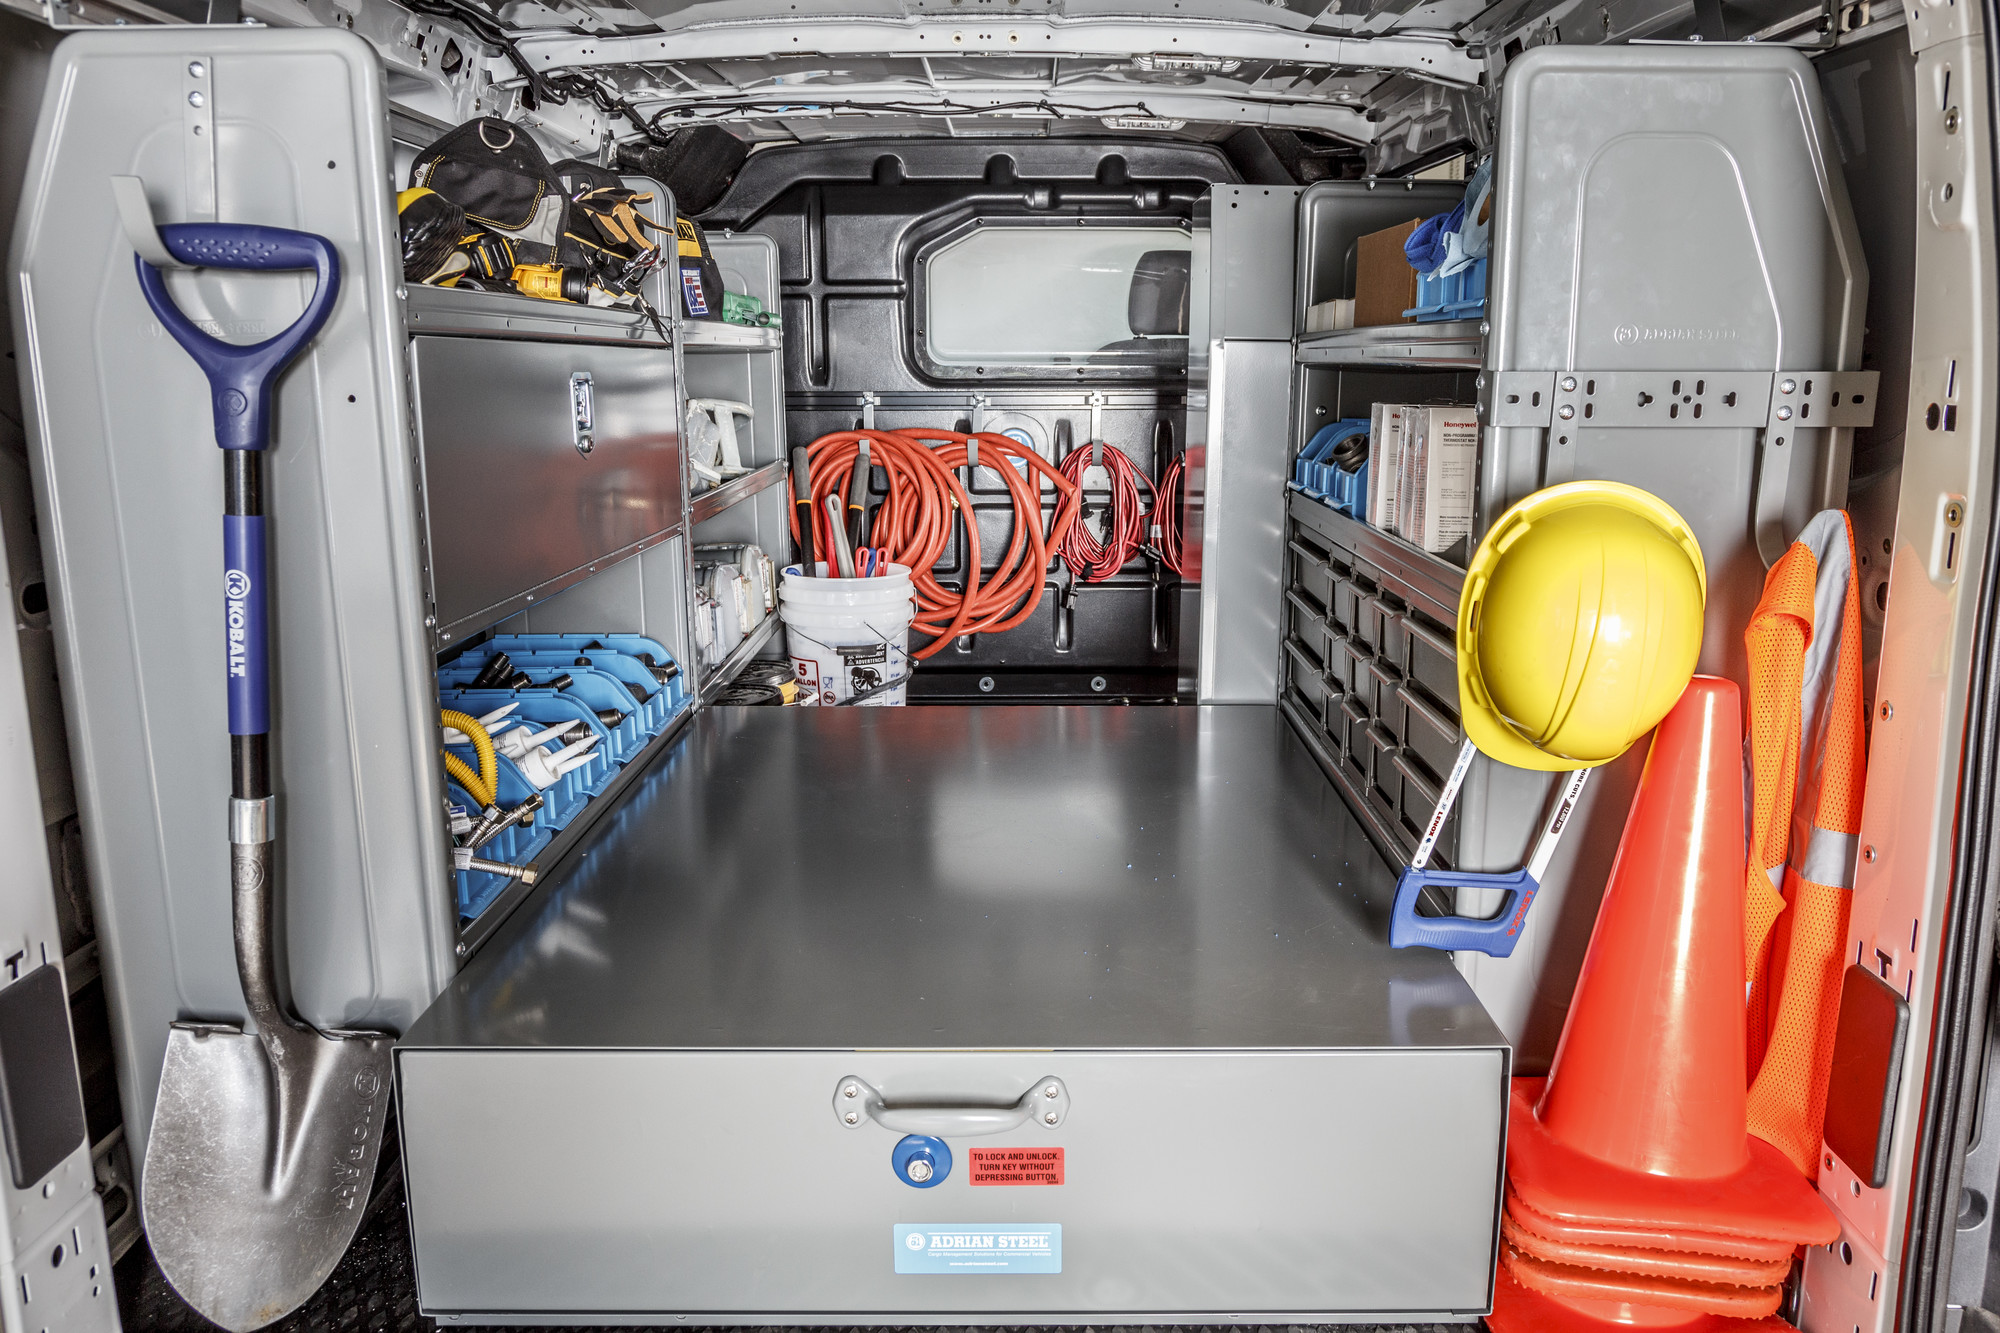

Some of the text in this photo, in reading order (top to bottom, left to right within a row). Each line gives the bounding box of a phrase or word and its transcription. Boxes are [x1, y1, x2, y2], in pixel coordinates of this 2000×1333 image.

[228, 600, 246, 677] KOBALT
[855, 657, 885, 665] ADVERTENCIA
[798, 663, 808, 676] 5
[1429, 811, 1443, 837] LENOX
[1512, 890, 1534, 930] LENOX
[973, 1153, 983, 1161] TO
[985, 1153, 1006, 1161] LOCK
[1007, 1152, 1024, 1160] AND
[979, 1163, 1055, 1171] TURN KEY WITHOUT
[975, 1173, 1024, 1181] DEPRESSING
[930, 1235, 1049, 1248] ADRIAN STEEL
